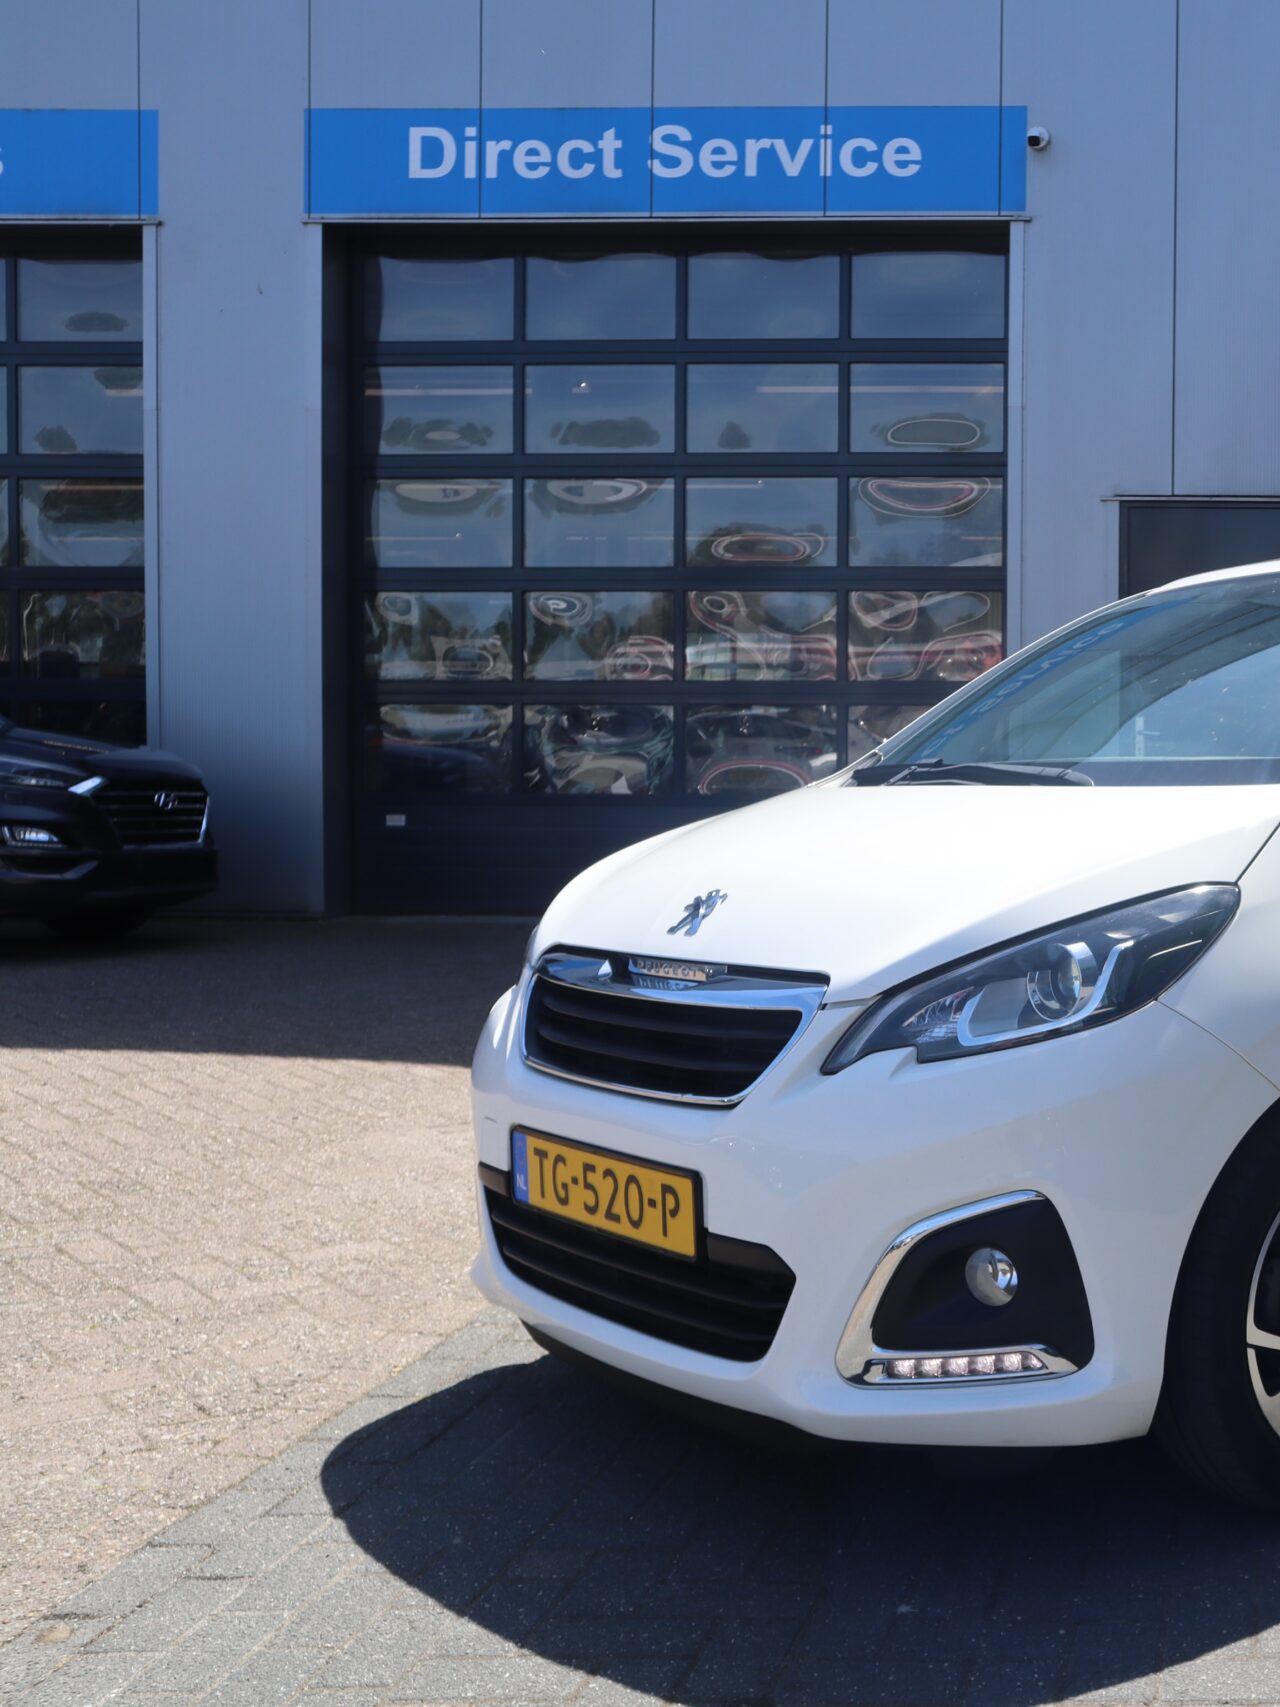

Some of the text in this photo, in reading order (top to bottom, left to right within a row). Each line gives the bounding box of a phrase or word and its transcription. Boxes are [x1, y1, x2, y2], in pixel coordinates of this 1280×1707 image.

[408, 124, 923, 179] Direct Service
[637, 960, 697, 977] PEUGEOT
[516, 1173, 528, 1191] NL
[533, 1147, 681, 1238] TG-520-P
